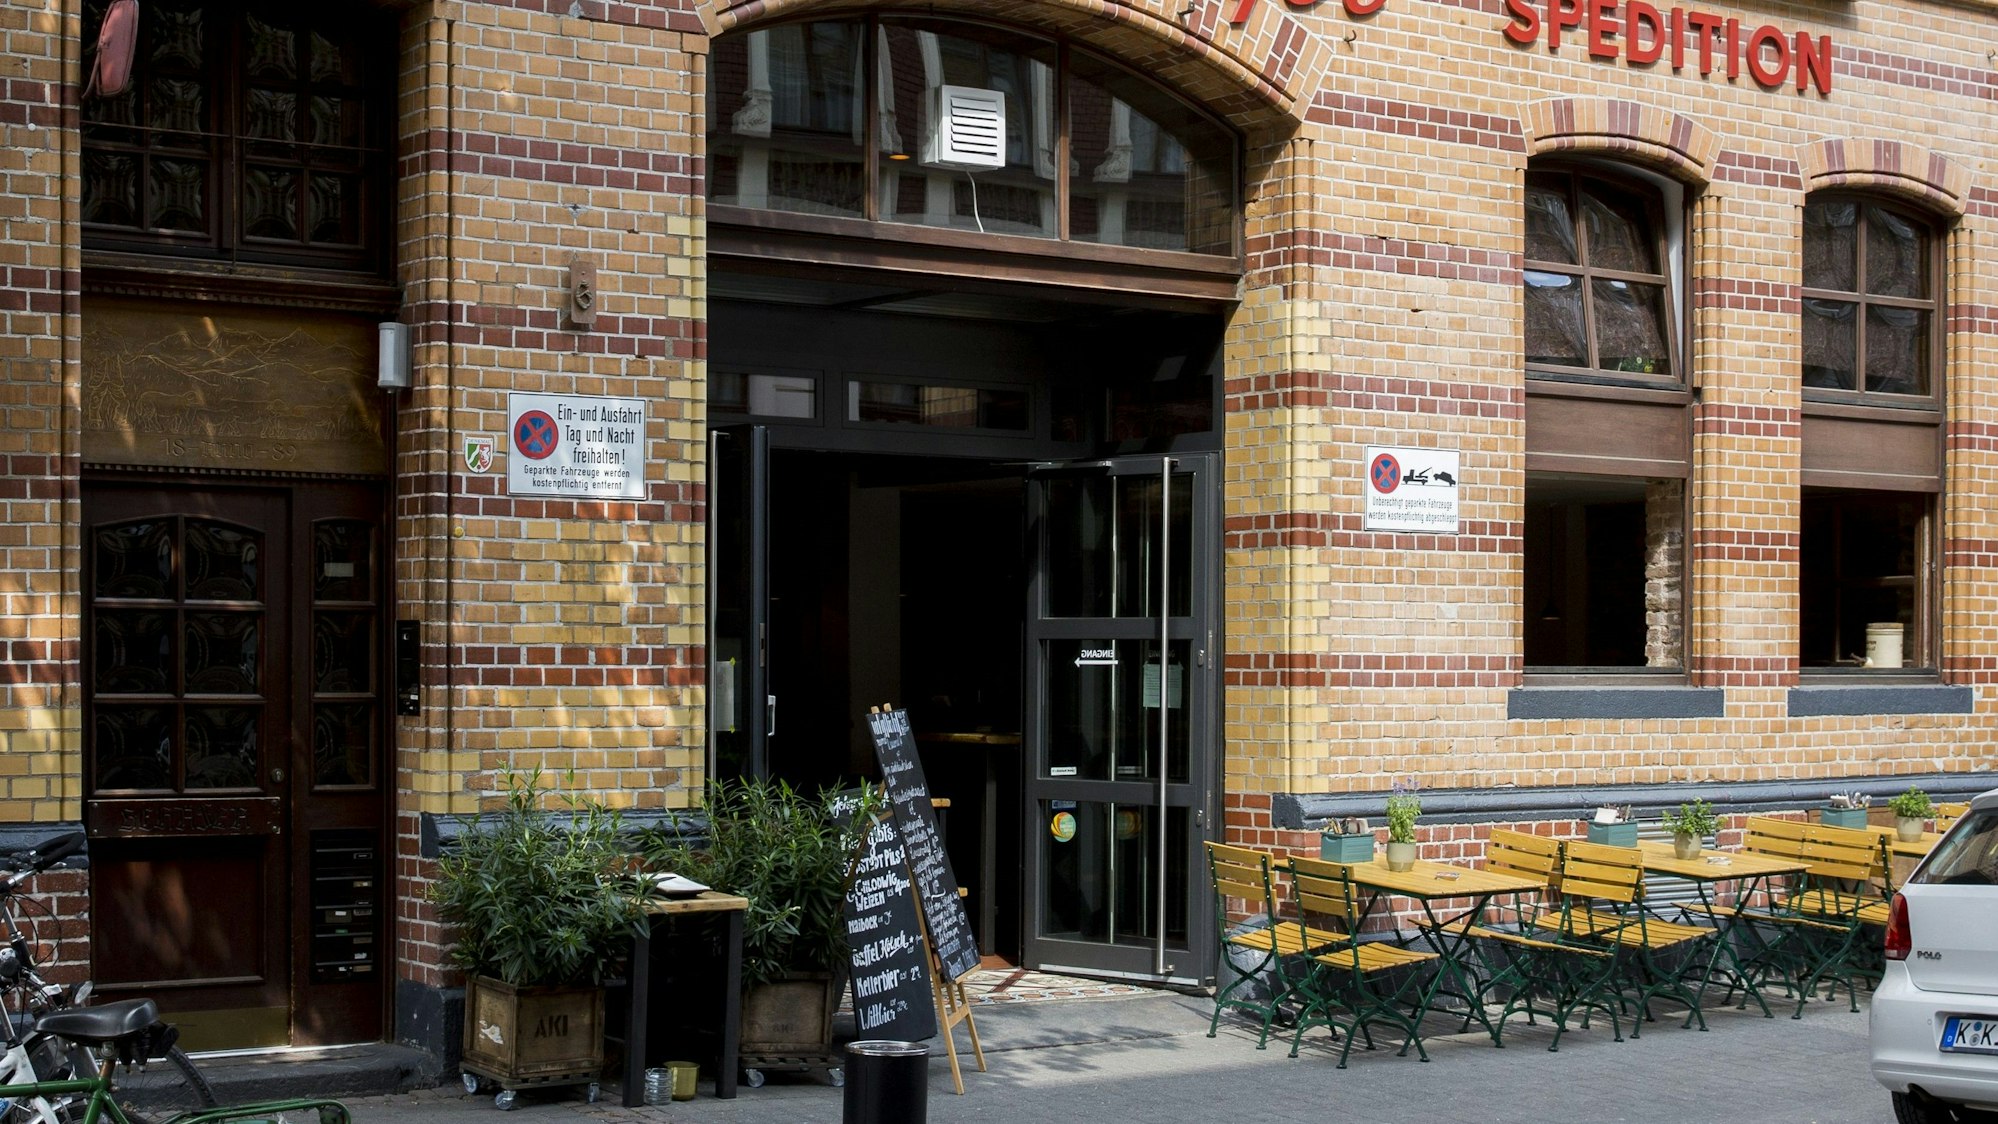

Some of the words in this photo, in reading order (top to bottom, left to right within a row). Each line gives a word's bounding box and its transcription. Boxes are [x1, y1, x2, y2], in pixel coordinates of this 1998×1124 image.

[1502, 0, 1832, 95] SPEDITION
[557, 403, 577, 421] Ein-
[580, 405, 597, 422] und
[600, 406, 642, 424] Ausfahrt
[565, 424, 581, 445] Tag
[586, 426, 603, 443] und
[607, 427, 635, 445] Nacht
[573, 448, 626, 465] freihalten!
[524, 464, 557, 476] Geparkte
[561, 465, 600, 478] Fahrzeuge
[604, 468, 630, 478] werden
[532, 477, 589, 491] kostenpflichtig
[592, 480, 622, 490] entfernt
[1372, 496, 1404, 510] Unberechtigt
[1405, 498, 1427, 510] geparkte
[1428, 498, 1453, 512] Fahrzeuge
[1368, 510, 1387, 520] werden
[1387, 511, 1425, 524] kostenpflichtig
[1425, 512, 1457, 525] abgeschleppt
[1917, 950, 1942, 960] POLO
[856, 969, 900, 998] Kellerbier
[534, 1015, 569, 1038] AKI
[1955, 1022, 1971, 1045] K
